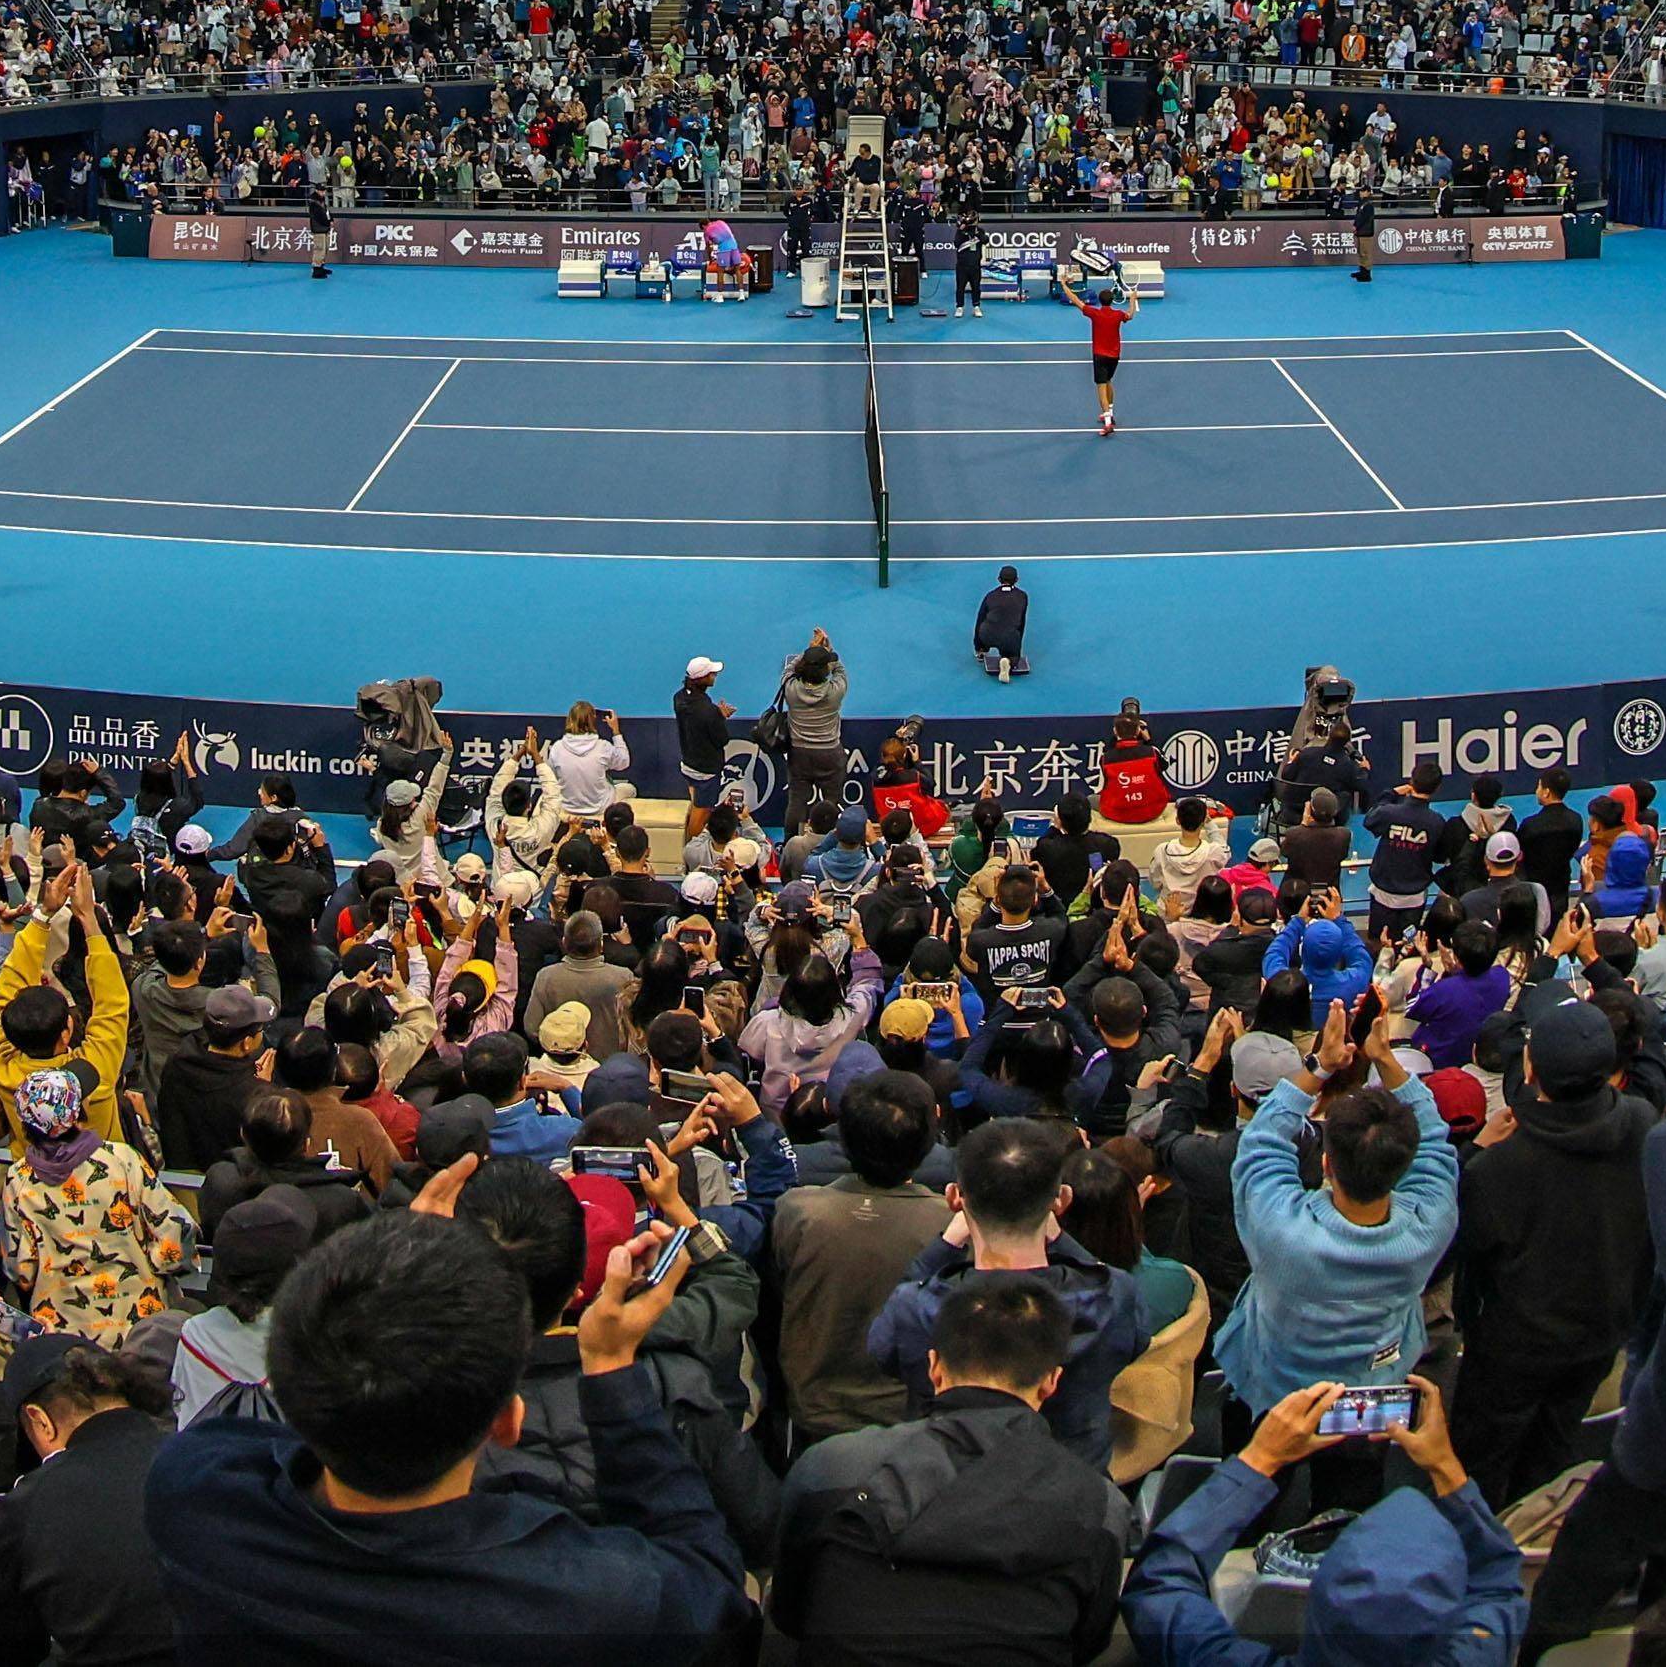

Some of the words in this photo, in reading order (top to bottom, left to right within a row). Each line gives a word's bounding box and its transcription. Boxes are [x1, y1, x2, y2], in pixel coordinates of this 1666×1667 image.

[173, 221, 220, 242] 昆仑山
[375, 225, 414, 241] PICC
[481, 231, 544, 248] 嘉实基金
[561, 227, 641, 246] Emirates
[1201, 227, 1247, 247] 特仑苏
[1404, 229, 1466, 245] 中信银行
[1487, 225, 1548, 240] 央视体育
[674, 232, 706, 251] AT
[985, 232, 1057, 248] OLOGIC
[1102, 242, 1134, 253] luckin
[1137, 242, 1170, 253] coffee
[1311, 232, 1355, 248] 天坛整
[1508, 240, 1554, 251] SPORTS
[349, 244, 439, 258] 中国人民保险
[481, 246, 517, 255] Harvest
[519, 247, 544, 255] Fund
[1428, 245, 1446, 253] CITIC
[68, 715, 161, 750] 品品香
[1402, 710, 1587, 778] Haier
[251, 747, 322, 773] luckin
[328, 753, 378, 778] coff
[1124, 792, 1143, 803] 143
[1389, 824, 1428, 844] FILA
[987, 946, 1019, 975] KAPPA
[1021, 939, 1050, 965] SPORT
